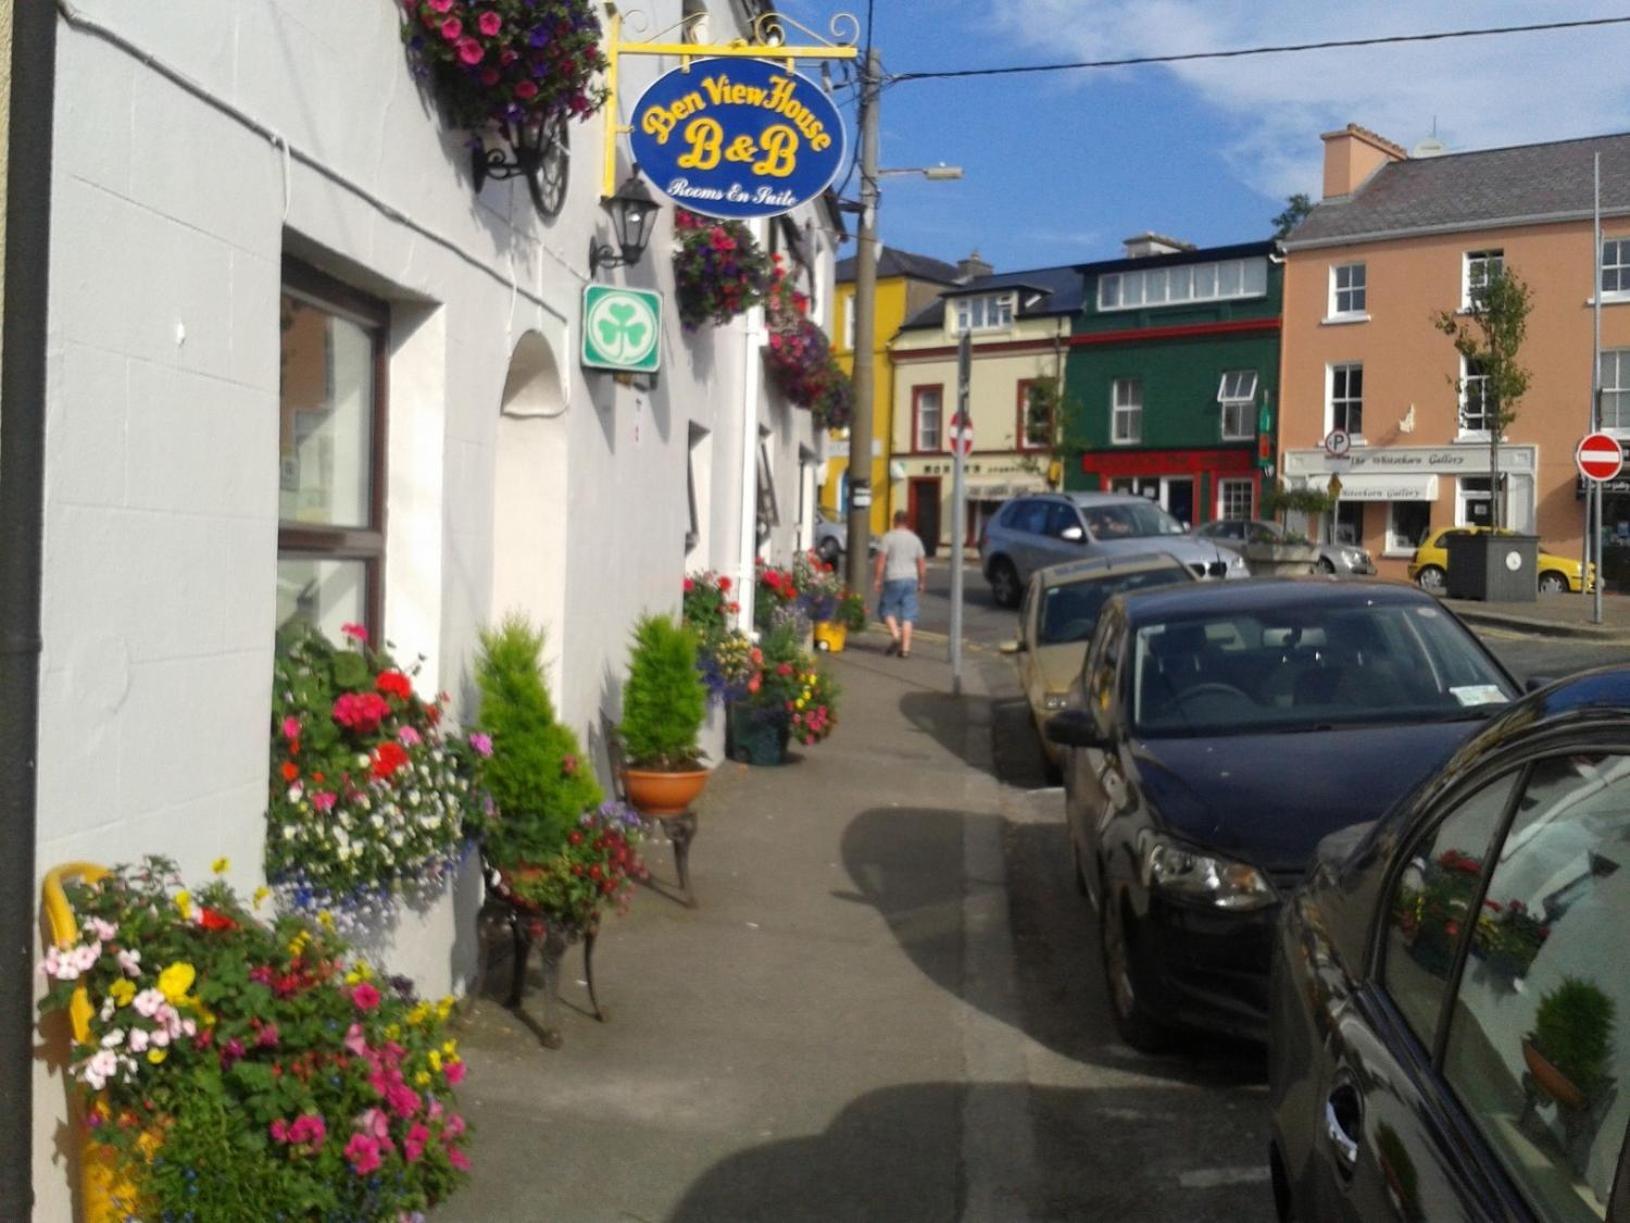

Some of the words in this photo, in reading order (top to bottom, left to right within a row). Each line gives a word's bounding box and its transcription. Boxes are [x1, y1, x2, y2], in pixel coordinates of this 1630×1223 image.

[642, 91, 706, 144] Ben
[702, 74, 766, 106] View
[763, 75, 832, 152] House
[667, 177, 723, 201] Rooms
[726, 183, 750, 203] En
[753, 186, 797, 207] Suite
[1429, 453, 1465, 465] Gallery
